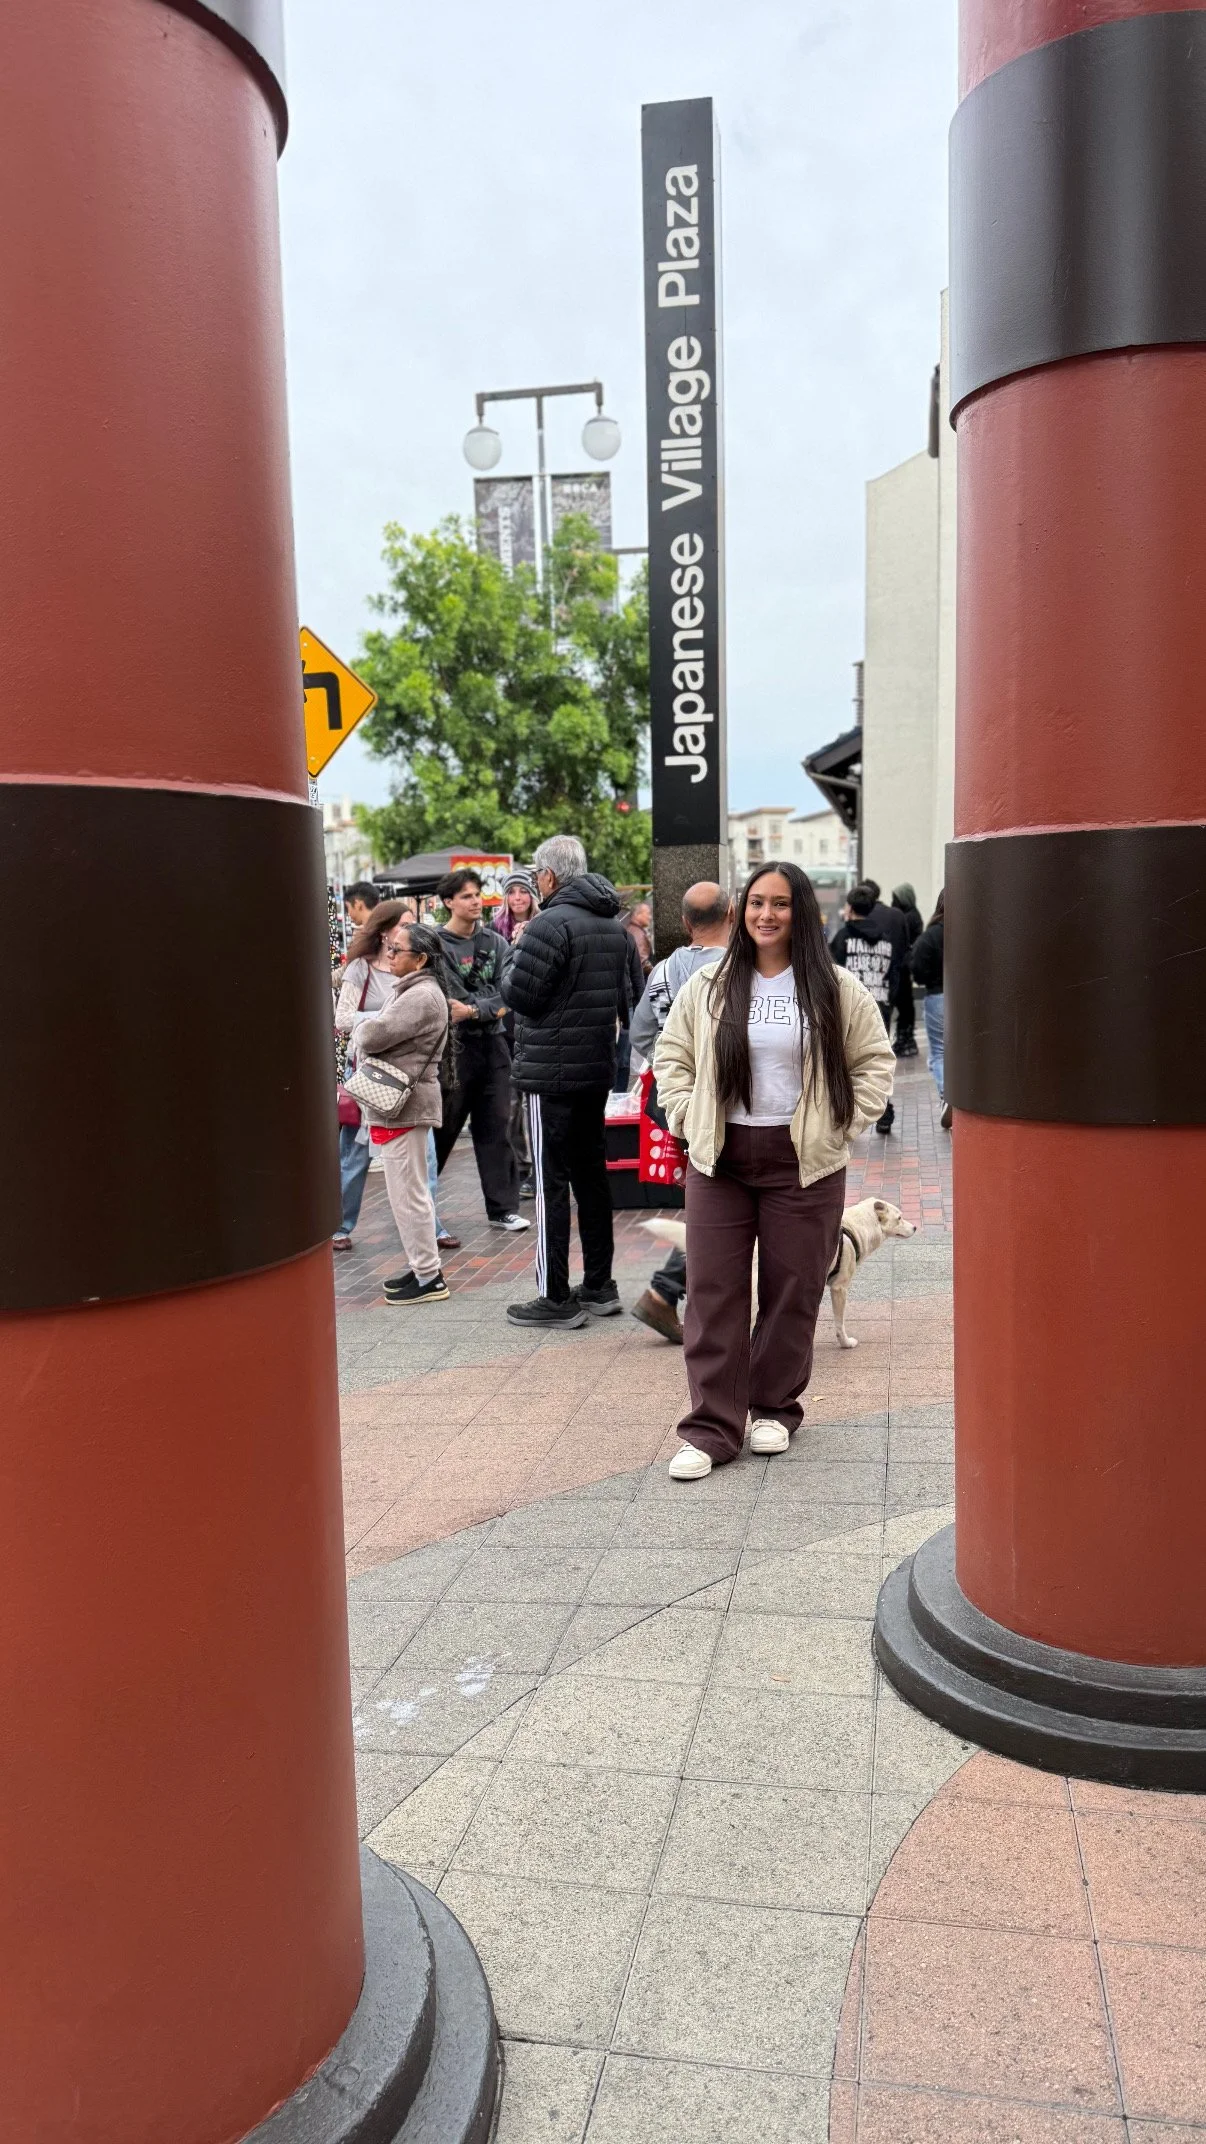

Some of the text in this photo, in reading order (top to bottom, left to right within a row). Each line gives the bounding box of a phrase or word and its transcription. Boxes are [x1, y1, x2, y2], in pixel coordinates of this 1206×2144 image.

[657, 164, 714, 784] Japanese Village Plaza
[747, 995, 803, 1027] BE
